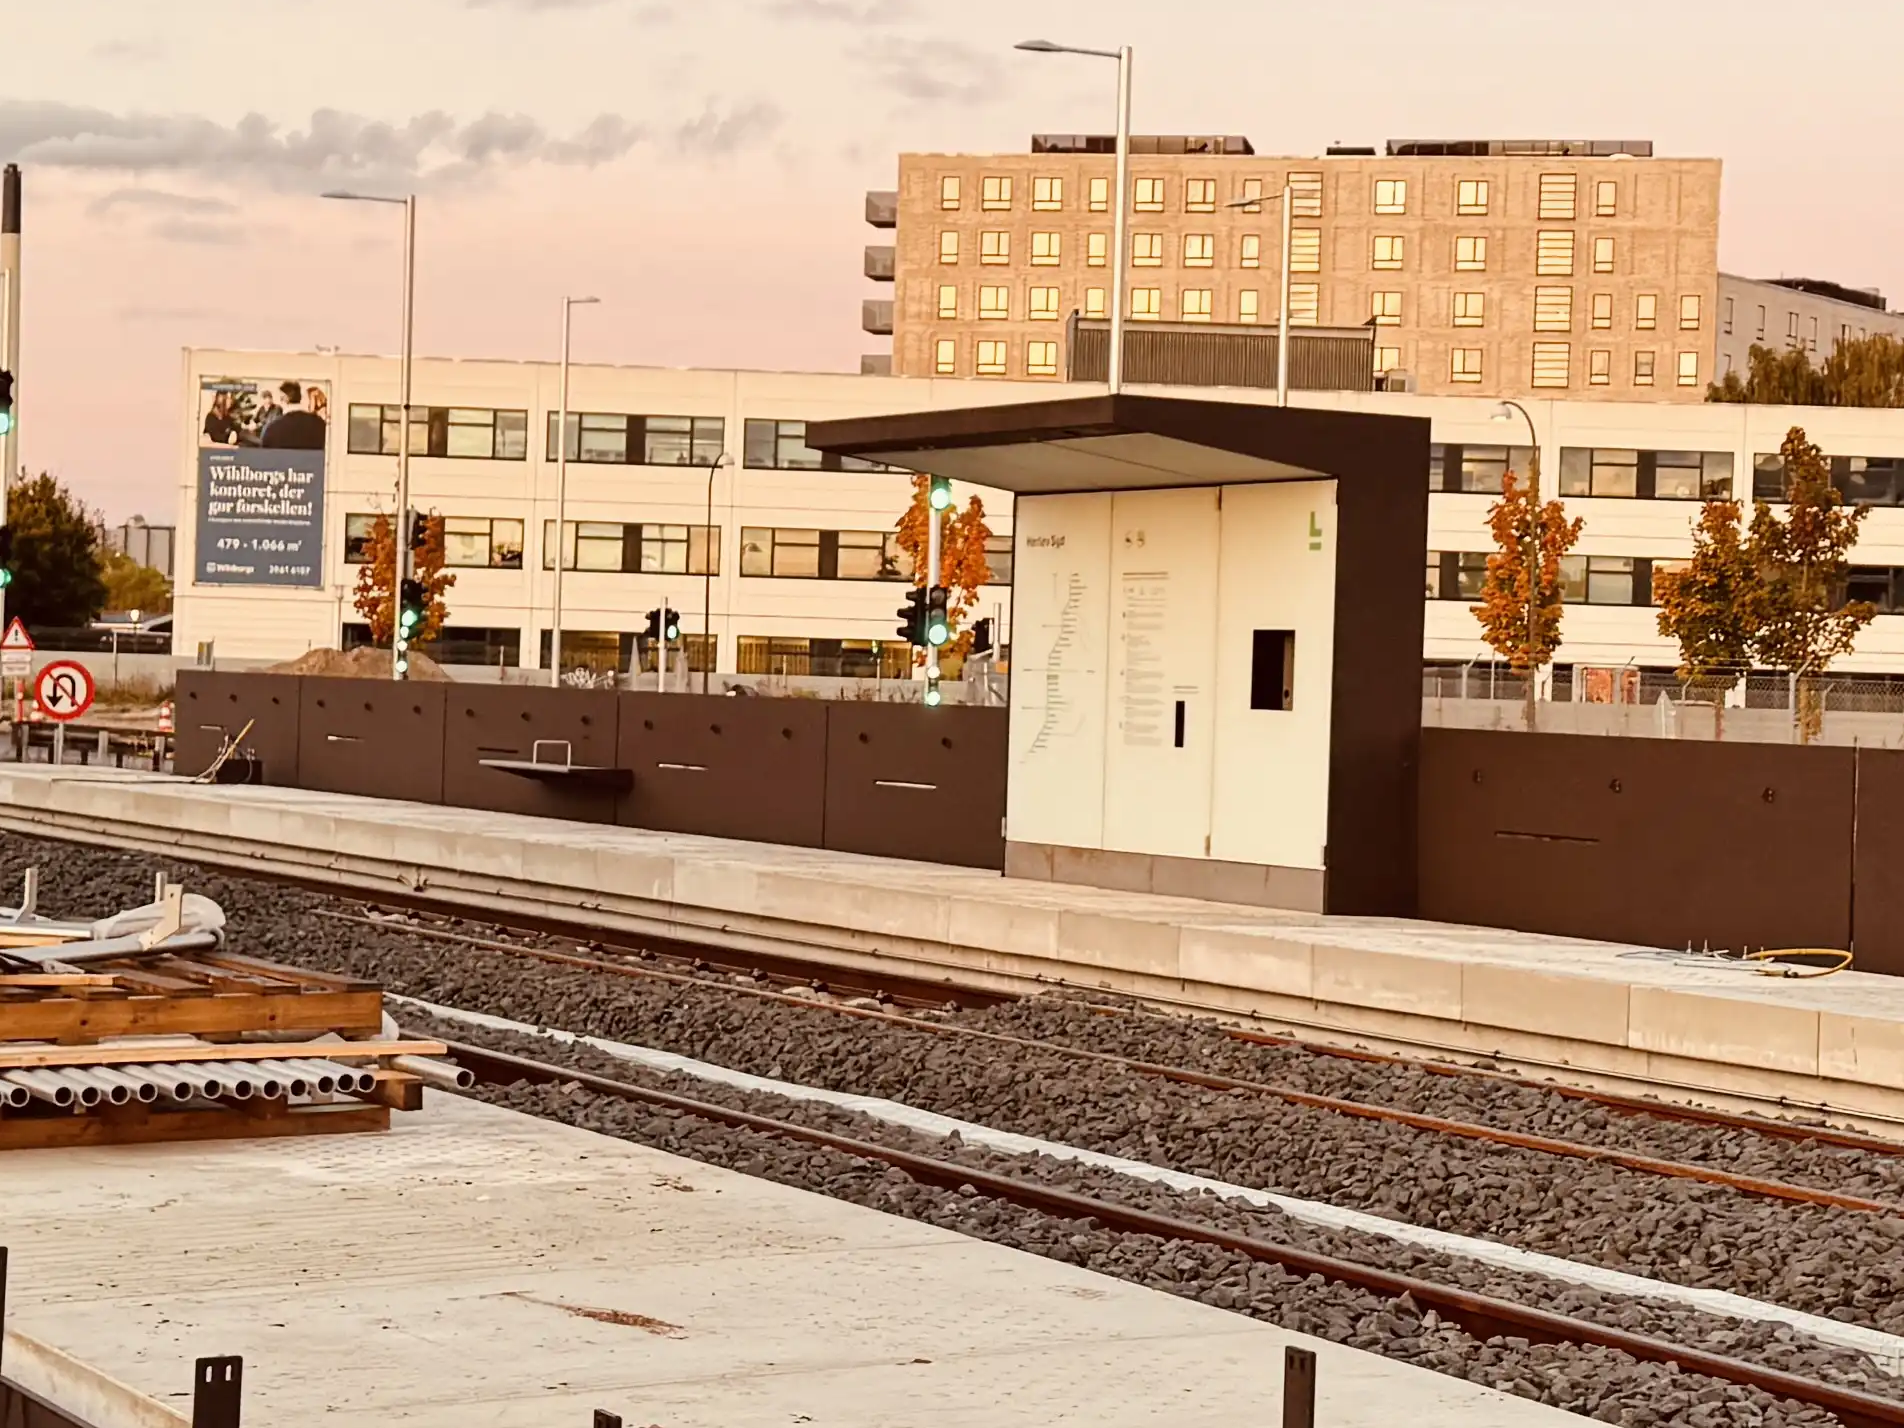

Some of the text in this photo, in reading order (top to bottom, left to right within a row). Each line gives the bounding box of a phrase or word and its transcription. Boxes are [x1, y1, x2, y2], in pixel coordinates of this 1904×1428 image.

[209, 465, 314, 484] Wihlborgs har
[210, 481, 304, 500] kontoret, der
[236, 499, 313, 516] forskellen!
[217, 538, 240, 549] 479
